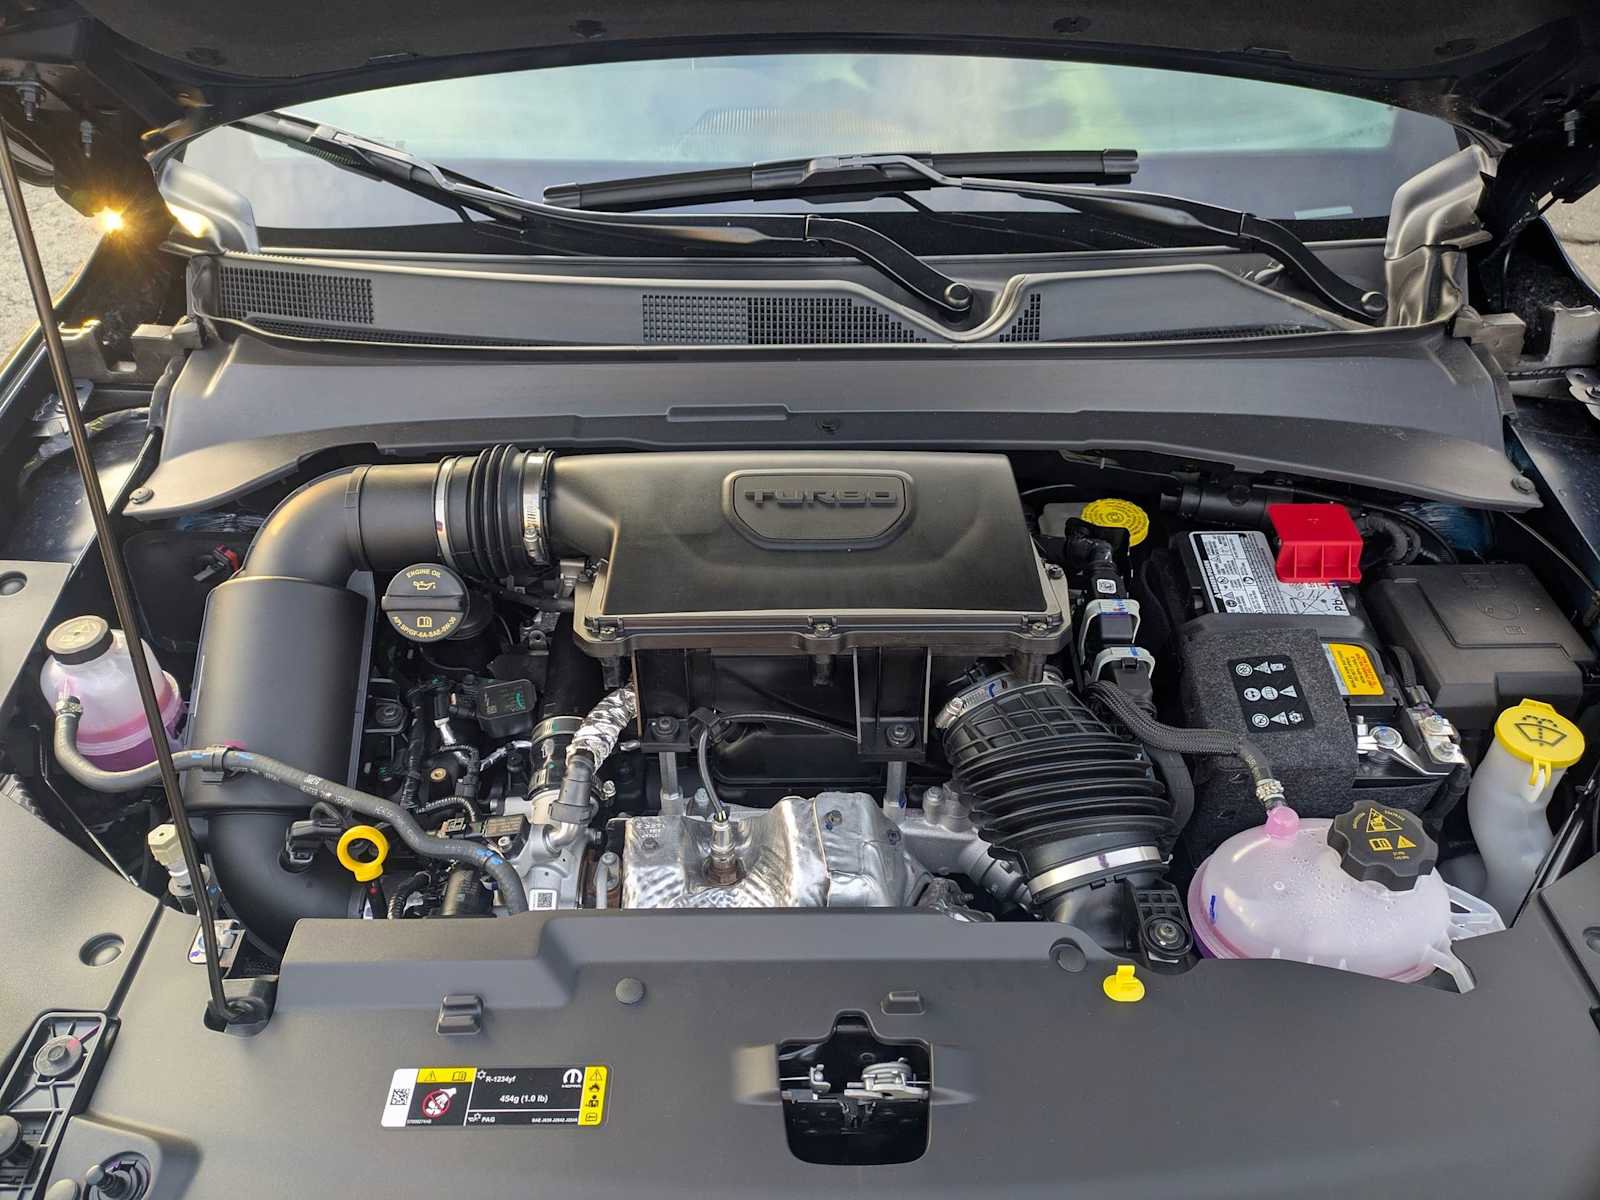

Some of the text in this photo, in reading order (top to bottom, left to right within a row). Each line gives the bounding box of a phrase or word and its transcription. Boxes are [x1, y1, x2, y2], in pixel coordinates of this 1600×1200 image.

[744, 488, 898, 508] TURBO
[406, 568, 431, 578] ENGINE
[485, 1075, 516, 1084] R-1234yf
[499, 1094, 549, 1104] 454g (1.0 lb)
[481, 1115, 496, 1123] PAG
